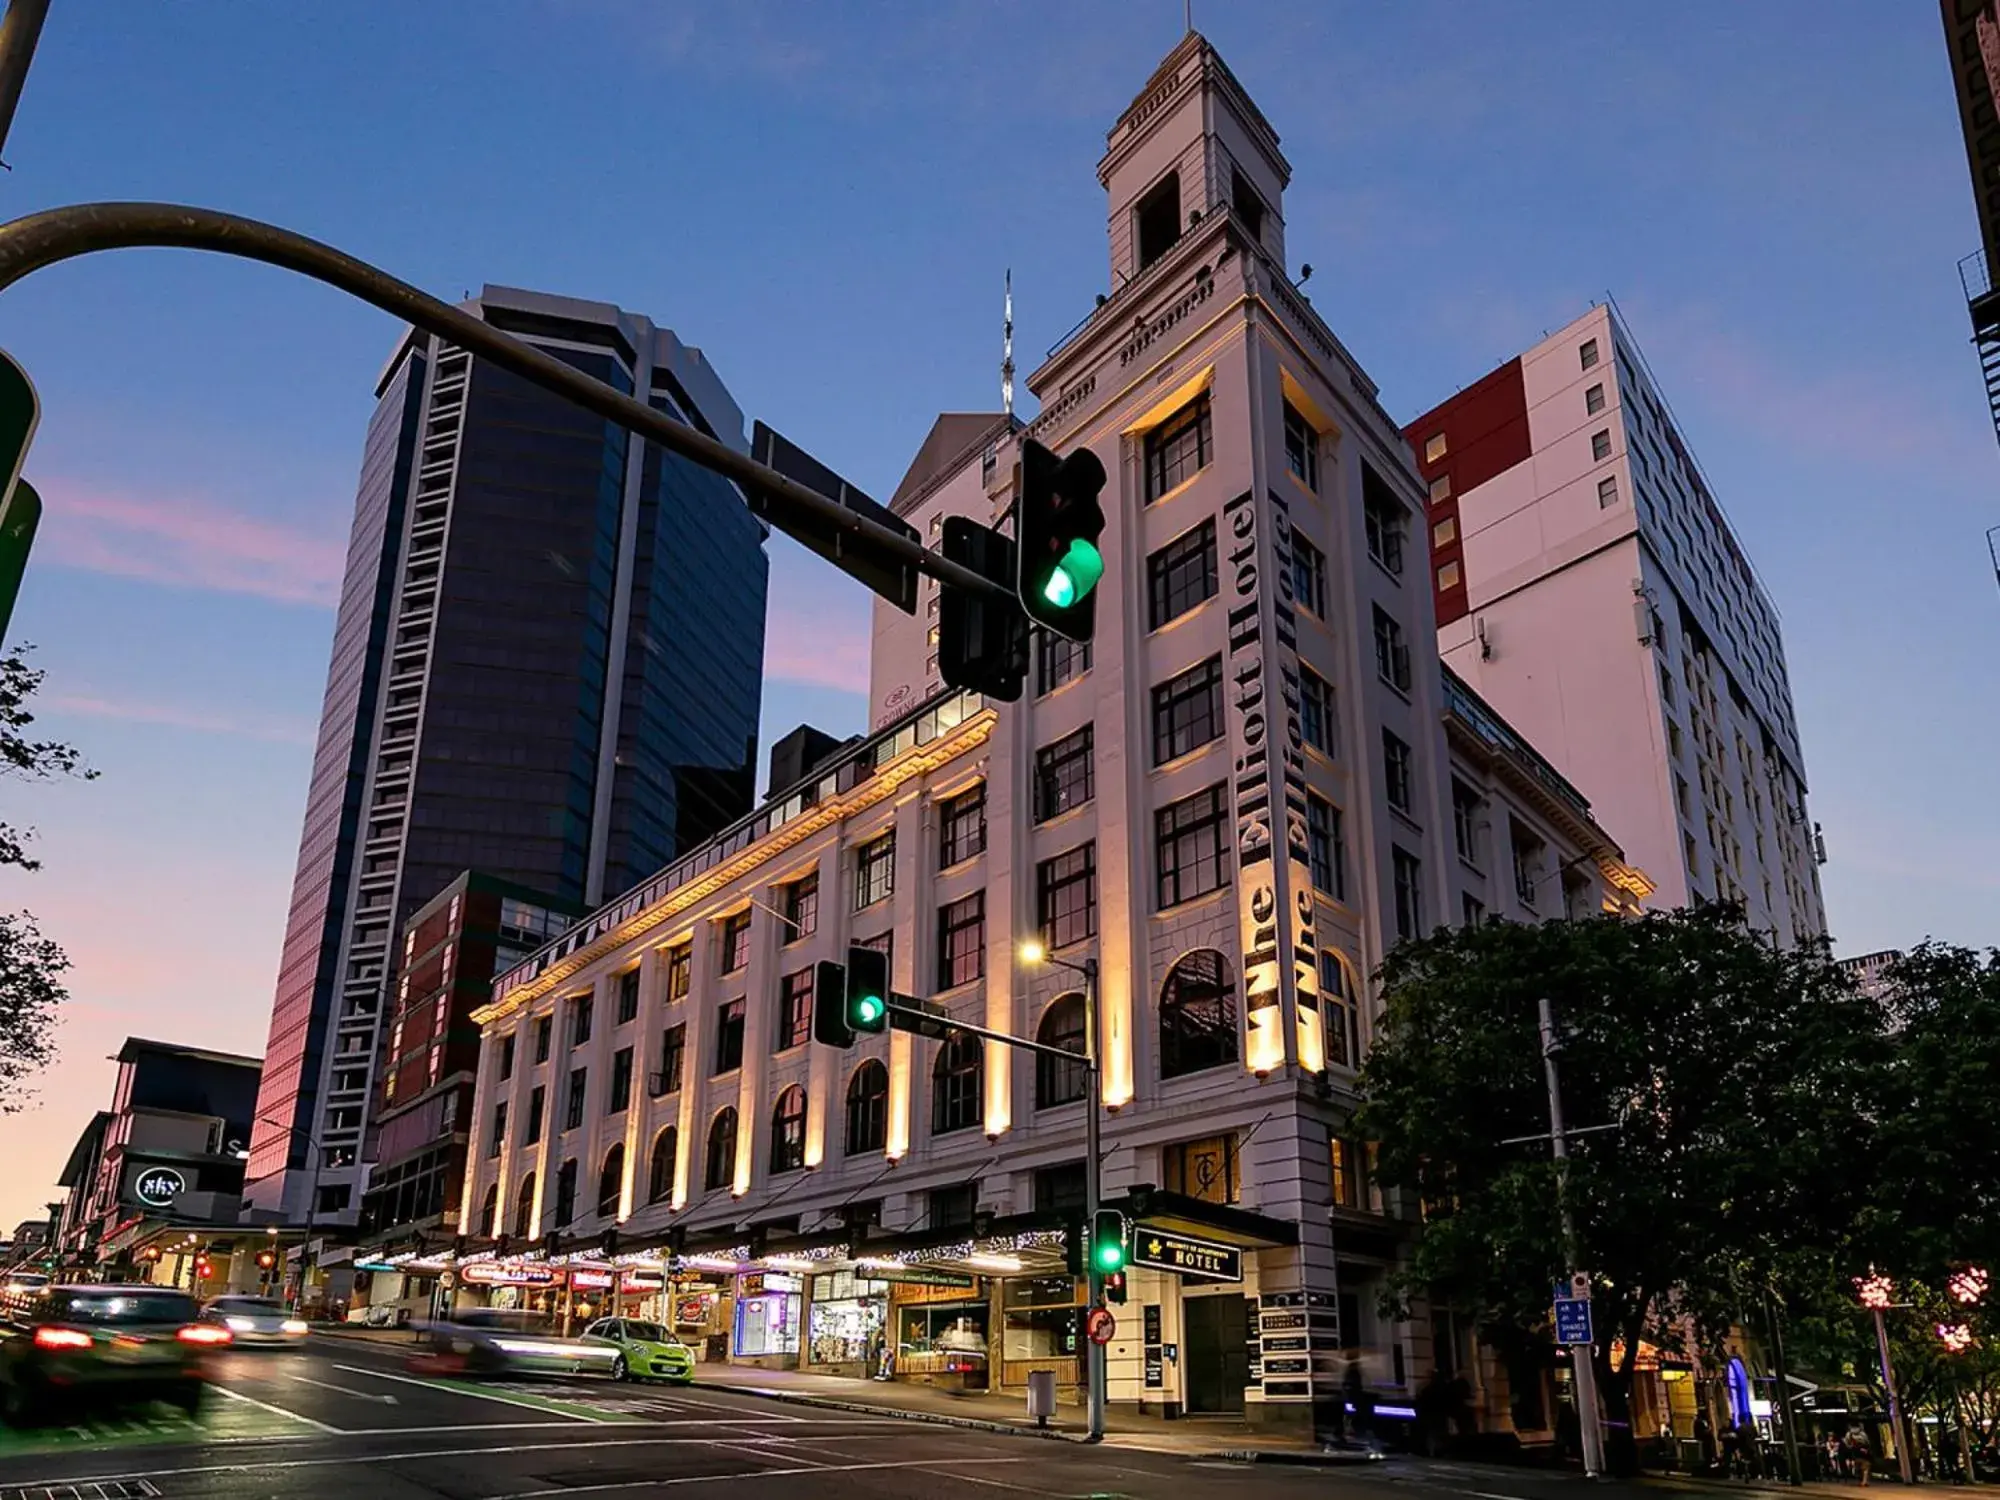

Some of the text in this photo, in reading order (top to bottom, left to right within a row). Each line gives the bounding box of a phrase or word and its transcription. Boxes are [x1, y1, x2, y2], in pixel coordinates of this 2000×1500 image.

[1223, 486, 1280, 1032] The Elliott Hotel
[1267, 486, 1320, 1026] The Elliott Hotel
[1175, 1250, 1221, 1270] HOTEL
